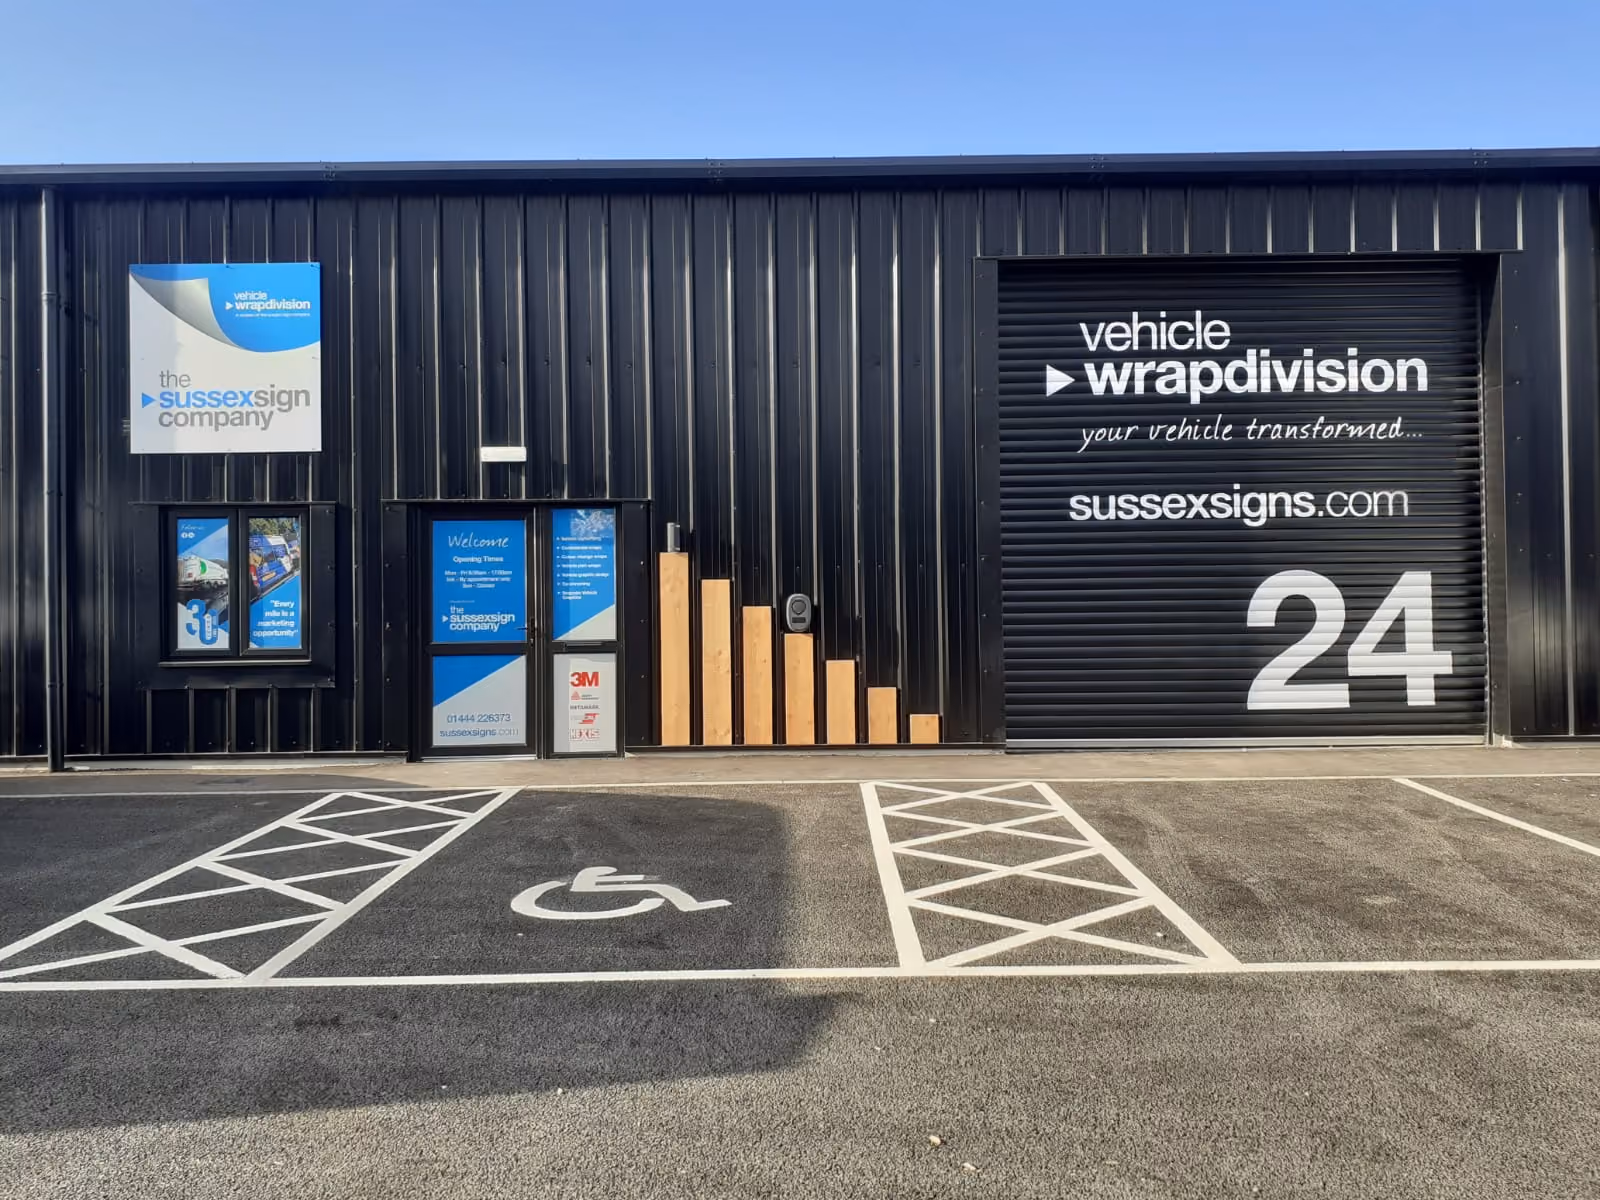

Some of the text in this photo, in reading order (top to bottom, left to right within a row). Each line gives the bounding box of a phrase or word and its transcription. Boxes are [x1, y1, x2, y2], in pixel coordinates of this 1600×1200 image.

[234, 291, 268, 300] vehicle
[235, 298, 311, 312] wrapdivision
[1079, 310, 1231, 351] vehicle
[159, 370, 192, 388] the
[1084, 347, 1429, 404] wrapdivision
[159, 384, 311, 413] sussexsign
[158, 410, 274, 431] company
[1077, 425, 1139, 453] your
[1149, 414, 1234, 441] vehicle
[1069, 483, 1410, 527] sussexsigns.com
[448, 532, 510, 548] Welcome
[450, 605, 464, 614] the
[450, 612, 515, 624] sussexsign
[449, 622, 500, 632] company
[1246, 569, 1453, 710] 24
[570, 671, 599, 688] 3M
[447, 713, 511, 723] 01444 226373
